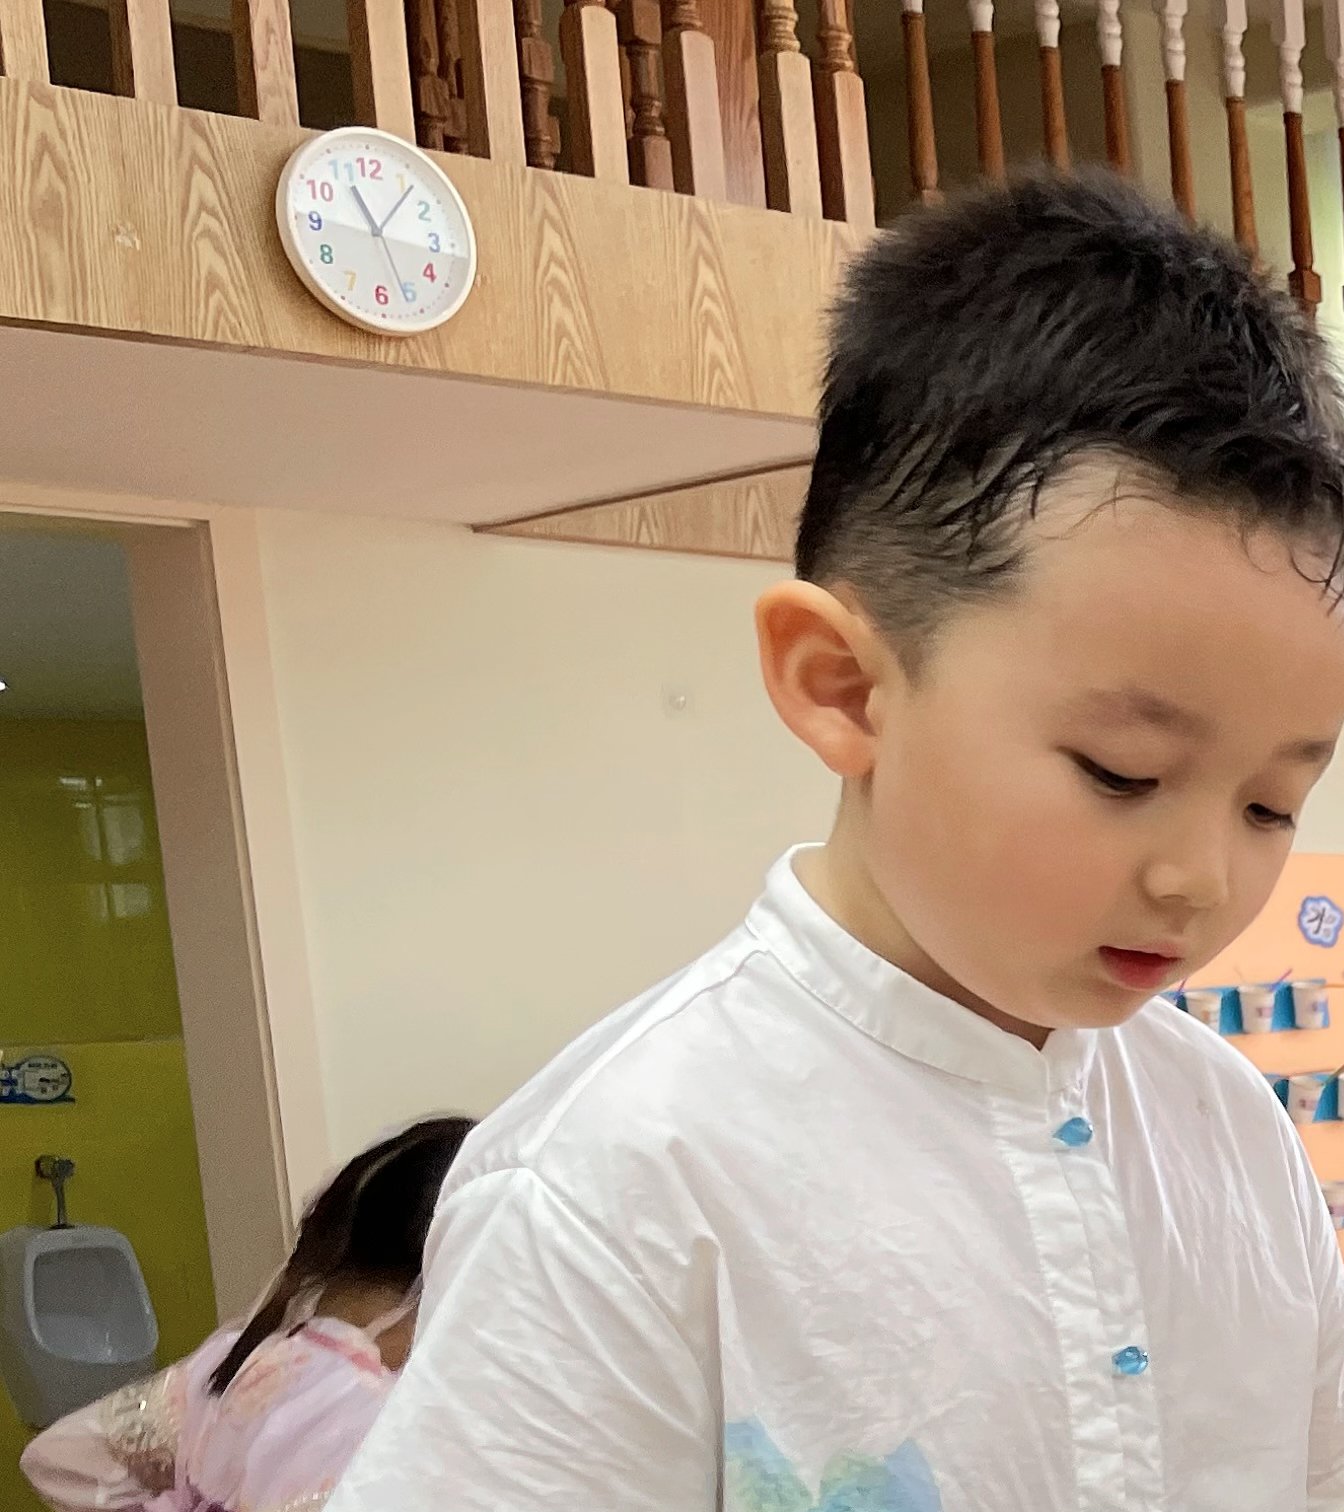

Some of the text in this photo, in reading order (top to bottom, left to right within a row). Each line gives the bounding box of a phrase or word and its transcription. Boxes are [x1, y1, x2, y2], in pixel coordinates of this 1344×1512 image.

[328, 159, 354, 182] 11
[356, 157, 383, 181] 12
[306, 179, 334, 202] 10
[308, 211, 323, 231] 9
[417, 201, 431, 222] 2
[428, 232, 441, 253] 3
[319, 244, 334, 264] 8
[343, 270, 357, 291] 7
[423, 263, 437, 283] 4
[374, 285, 389, 305] 6
